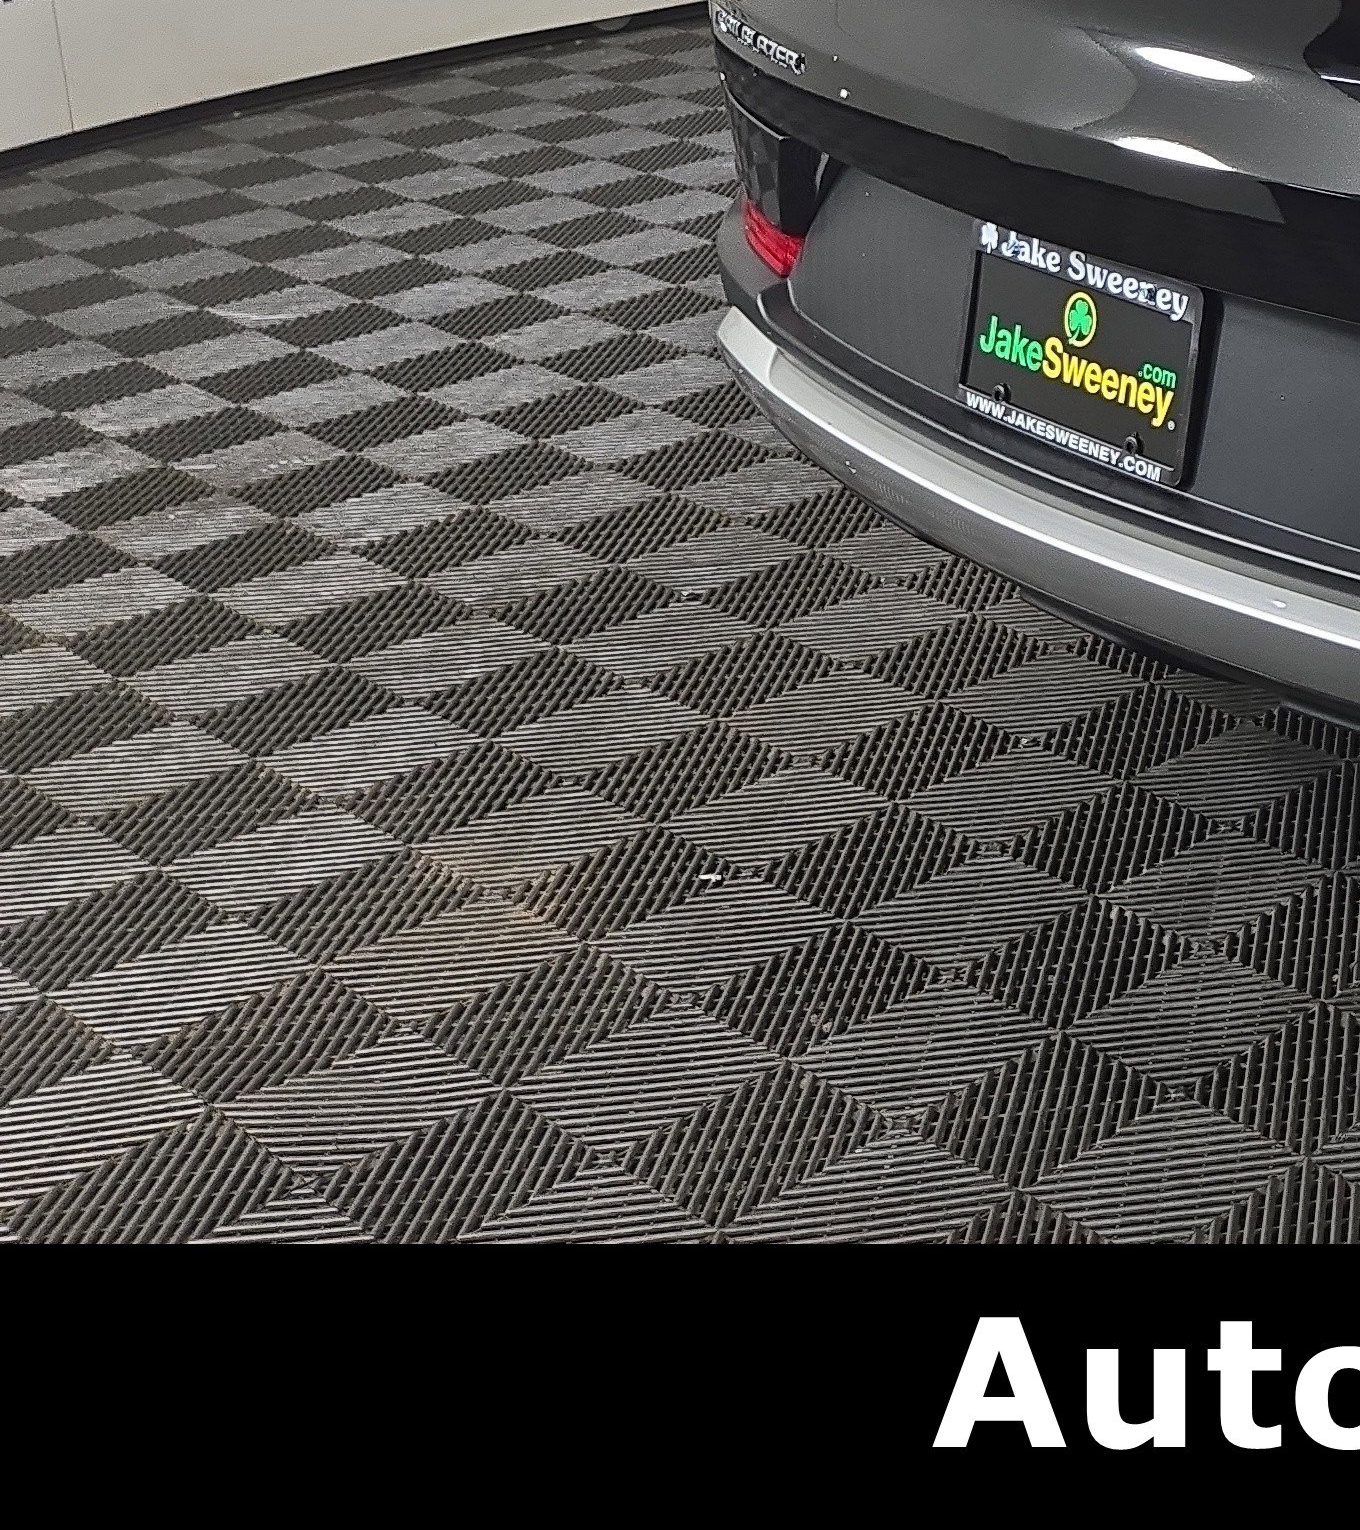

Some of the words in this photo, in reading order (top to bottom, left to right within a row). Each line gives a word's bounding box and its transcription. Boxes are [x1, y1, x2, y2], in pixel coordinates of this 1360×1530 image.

[1001, 230, 1061, 273] Jake
[1067, 250, 1190, 322] Sweeney
[1137, 363, 1177, 389] .com
[966, 391, 1163, 483] WWW.JAKESWEENEY.COM
